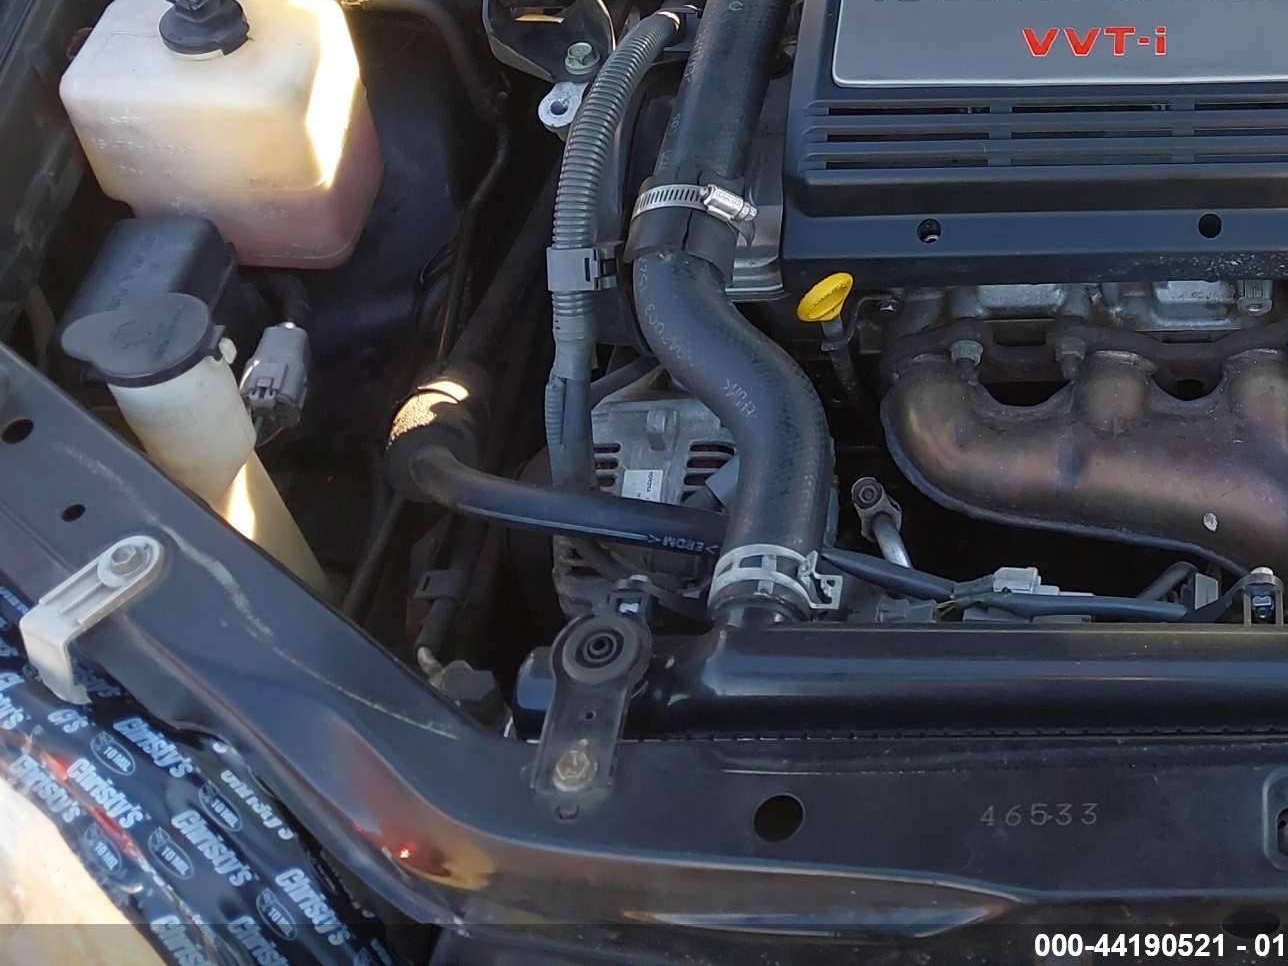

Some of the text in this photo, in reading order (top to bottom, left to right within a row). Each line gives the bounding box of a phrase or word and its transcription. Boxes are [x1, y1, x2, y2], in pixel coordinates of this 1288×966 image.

[1021, 26, 1167, 57] VVT-i
[112, 717, 193, 778] Christy's
[67, 757, 144, 829] Christy's
[980, 803, 1098, 826] 46533
[171, 810, 252, 886] Christy's
[275, 868, 351, 946] Christy's
